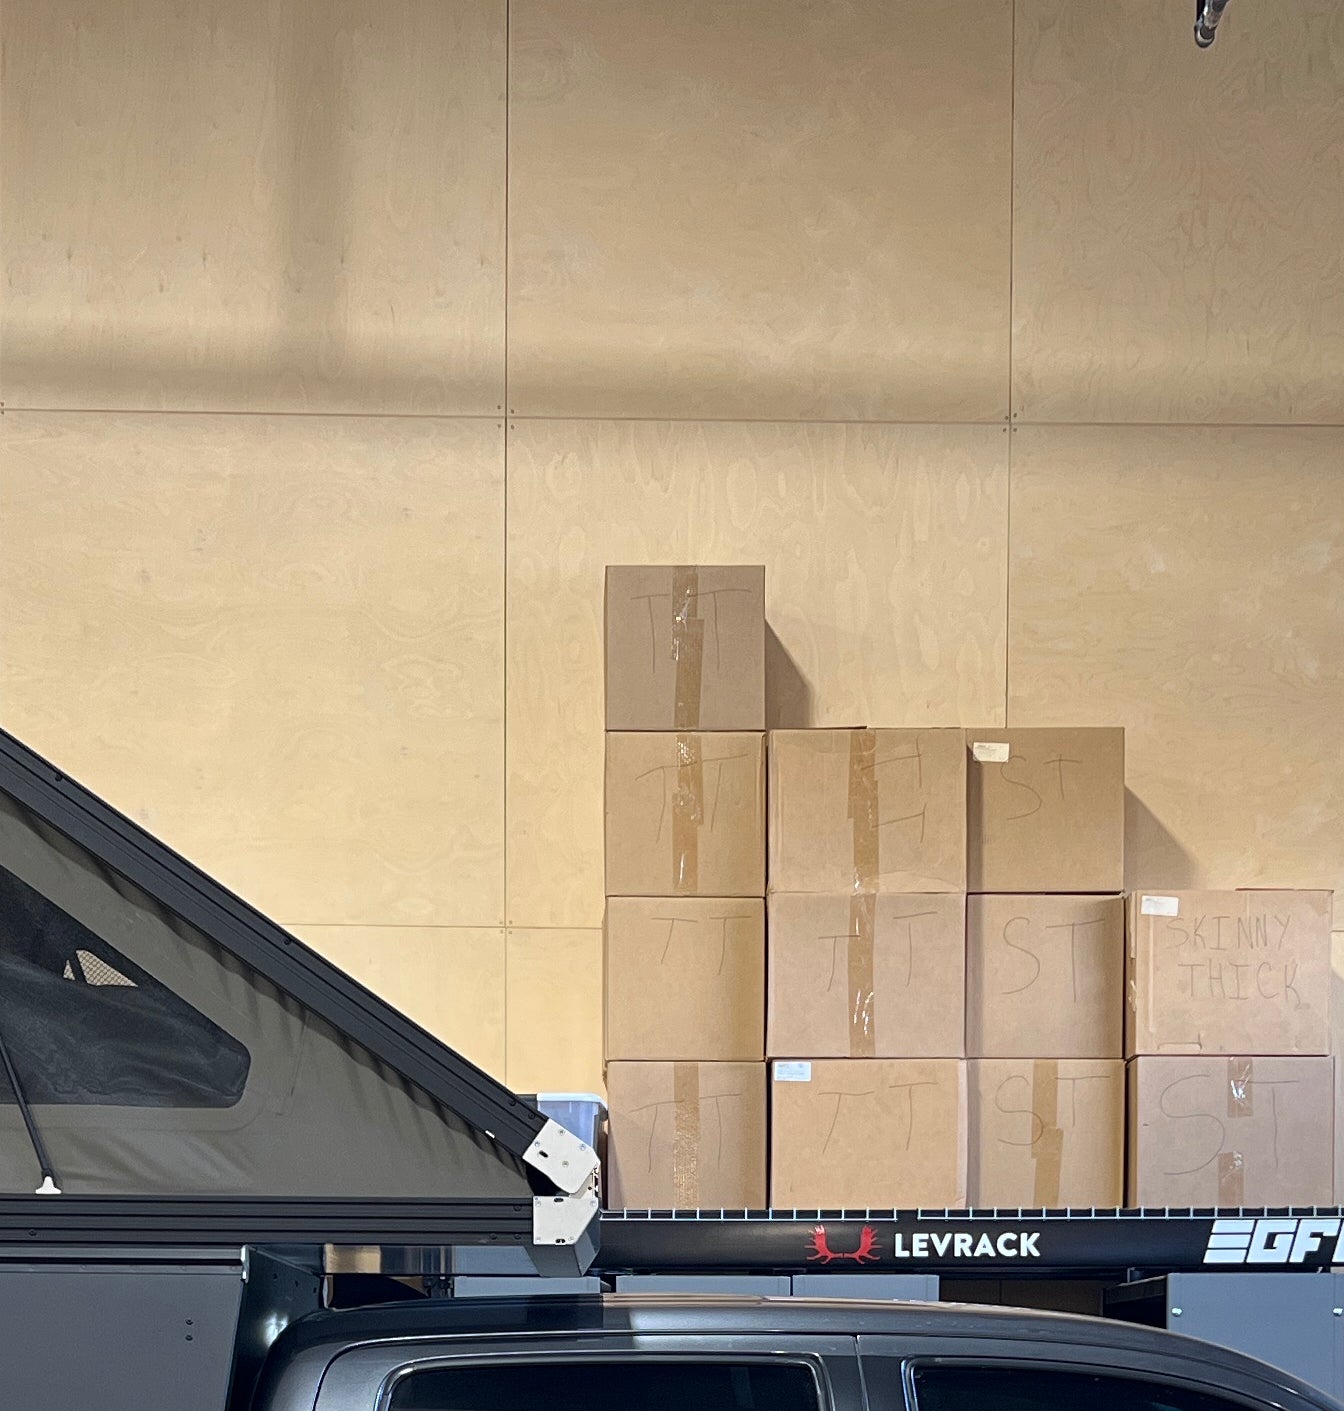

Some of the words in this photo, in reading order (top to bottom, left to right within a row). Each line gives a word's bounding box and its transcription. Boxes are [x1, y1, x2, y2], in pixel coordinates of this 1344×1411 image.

[1162, 914, 1291, 951] SKINNY
[1178, 959, 1302, 1009] THICK
[894, 1232, 1042, 1259] LEVRACK
